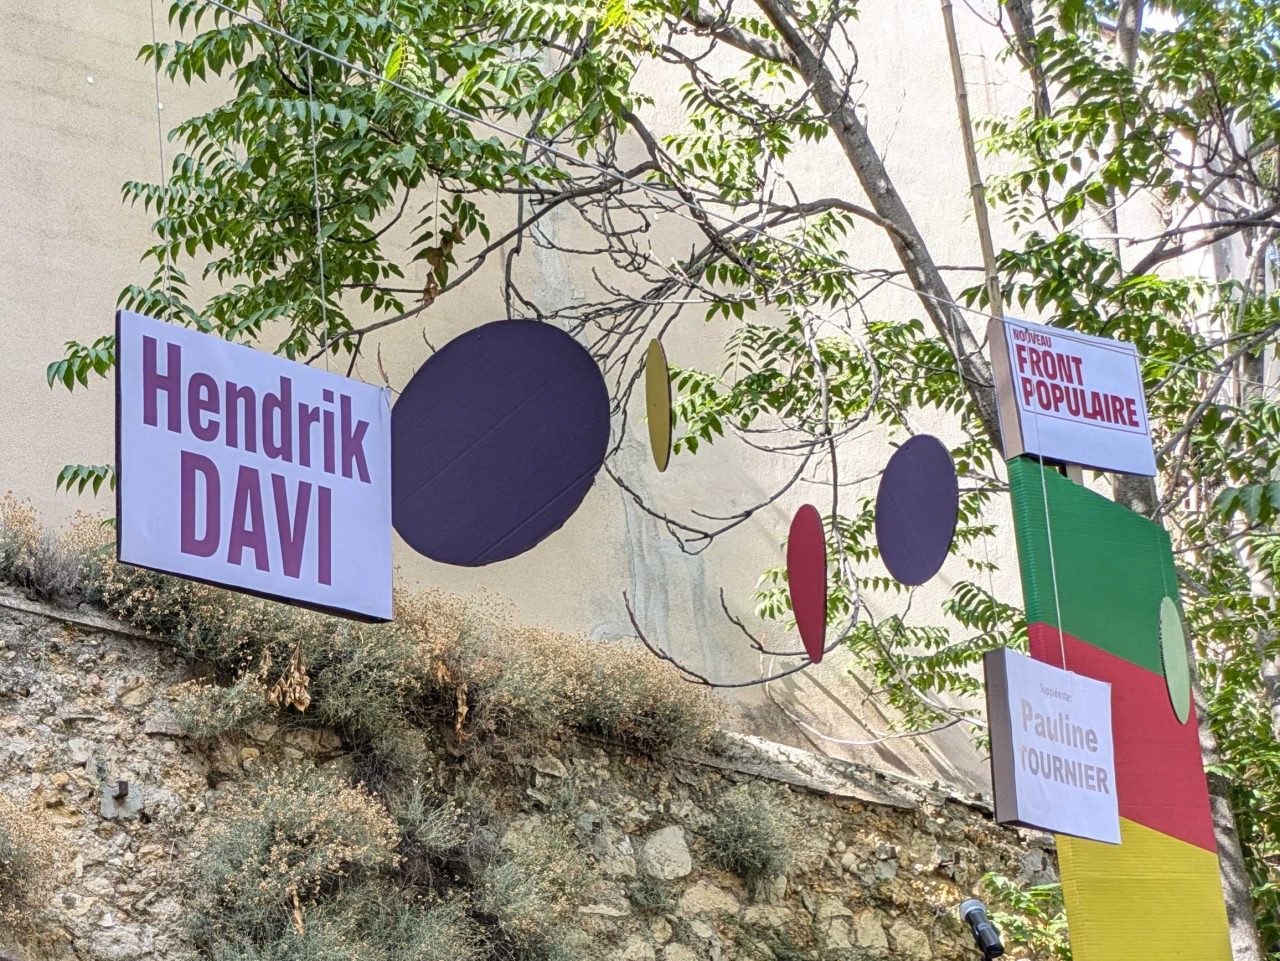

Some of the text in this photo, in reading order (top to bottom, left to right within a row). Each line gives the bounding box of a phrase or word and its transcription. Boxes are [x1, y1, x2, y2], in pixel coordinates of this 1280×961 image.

[1012, 328, 1052, 348] NOUVEAU
[1015, 343, 1084, 387] FRONT
[142, 334, 372, 485] Hendrik
[1020, 376, 1140, 428] POPULAIRE
[180, 449, 332, 586] DAVI
[1020, 698, 1099, 753] Pauline
